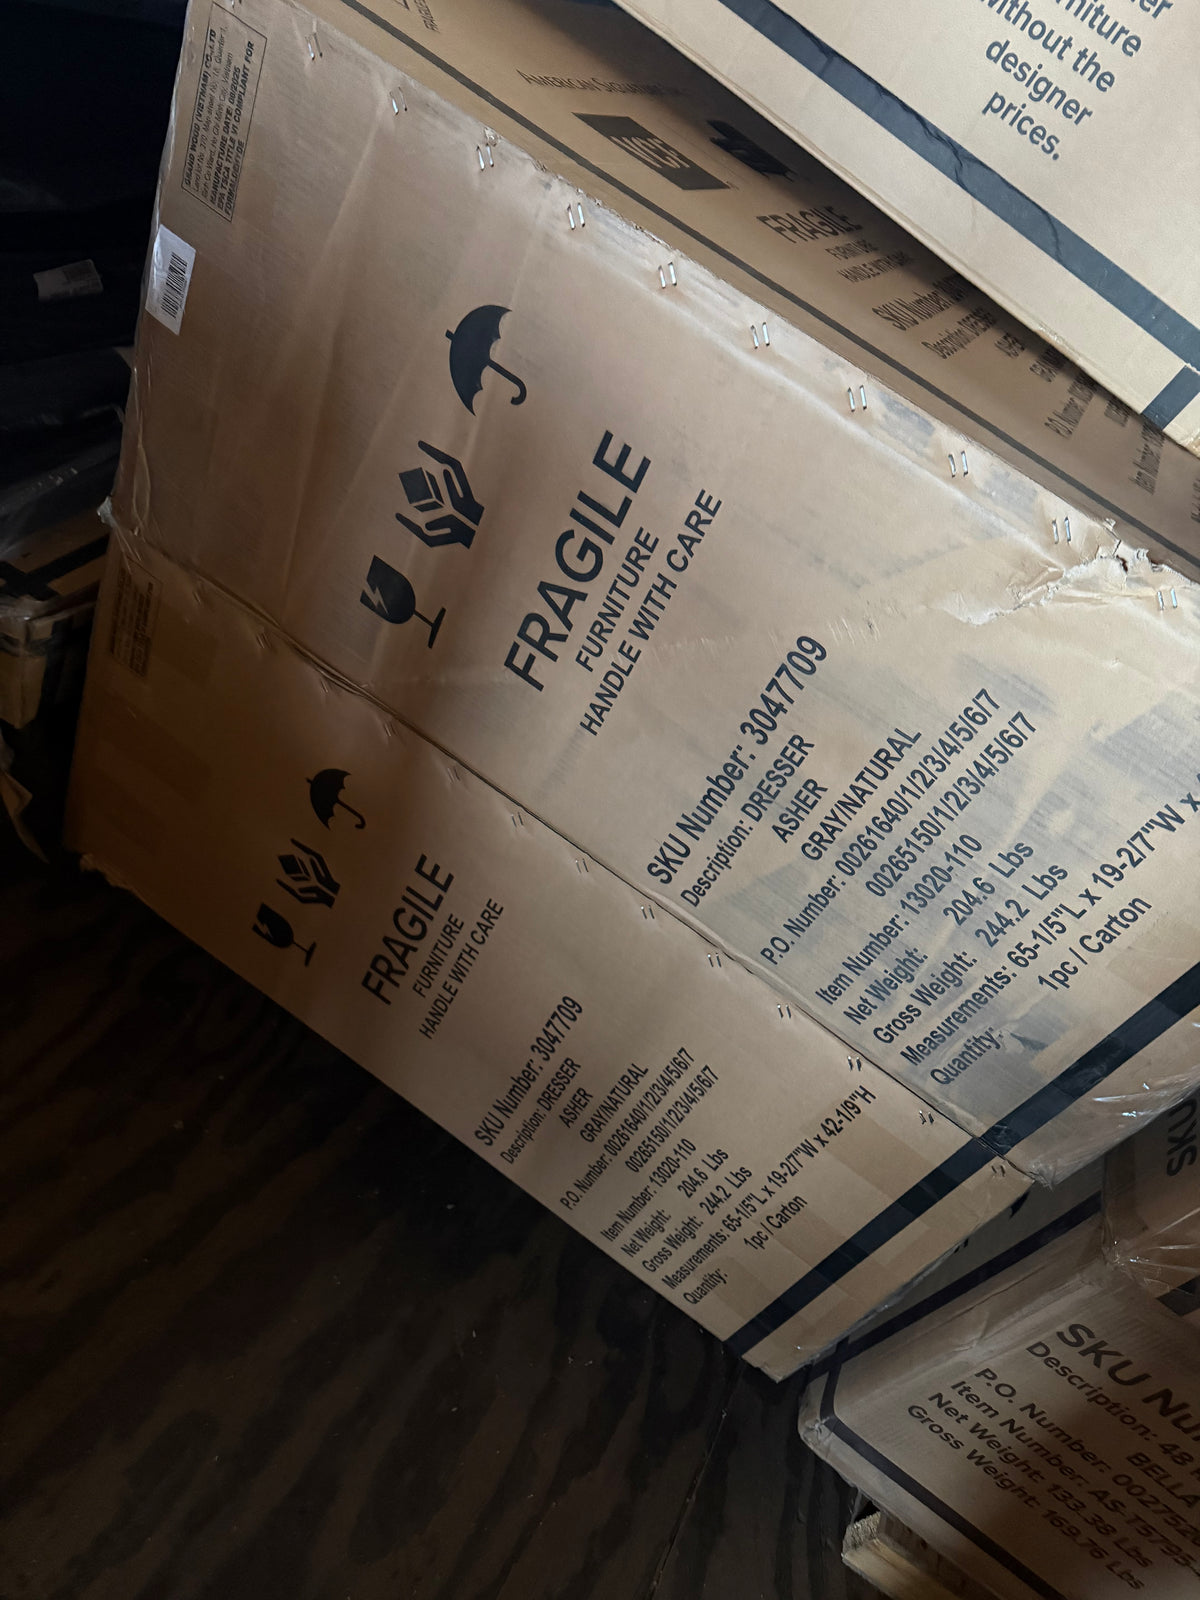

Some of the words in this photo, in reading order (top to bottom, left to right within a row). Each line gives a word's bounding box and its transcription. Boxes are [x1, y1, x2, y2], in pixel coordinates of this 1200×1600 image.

[220, 164, 230, 191] TSCA
[225, 135, 236, 164] TITLE
[233, 64, 249, 123] COMPLIANT
[244, 39, 254, 64] FOR
[985, 40, 1093, 125] designer
[1072, 48, 1115, 92] the
[190, 122, 200, 152] WOOD
[209, 134, 227, 205] MANUFACTURE
[222, 104, 233, 134] DATE:
[982, 92, 1060, 161] prices.
[756, 206, 863, 243] FRAGILE
[872, 297, 919, 331] SKU
[503, 430, 651, 692] FRAGILE
[575, 527, 660, 672] FURNITURE
[580, 640, 641, 736] HANDLE
[628, 573, 677, 640] WITH
[666, 489, 722, 573] CARE
[647, 833, 691, 885] SKU
[676, 745, 756, 841] Number:
[740, 635, 827, 745] 3047709
[772, 778, 829, 843] ASHER
[801, 728, 922, 861] GRAY/NATURAL
[865, 711, 1037, 897] 00265150/1/2/3/4/5/6/7
[681, 820, 753, 908] Description:
[741, 734, 815, 822] DRESSER
[760, 936, 795, 965] P.O.
[783, 875, 846, 937] Number:
[835, 688, 1000, 876] 00261640/1/2/3/4/5/6/7
[361, 854, 454, 1006] FRAGILE
[412, 913, 464, 998] FURNITURE
[419, 980, 458, 1039] HANDLE
[452, 943, 479, 985] WITH
[470, 899, 504, 945] CARE
[815, 973, 854, 1005] Item
[842, 914, 910, 977] Number:
[900, 834, 982, 914] 13020-110
[843, 995, 878, 1025] Net
[865, 948, 928, 1001] Weight:
[943, 877, 996, 926] 204.6
[988, 840, 1034, 878] Lbs
[873, 1004, 922, 1044] Gross
[910, 952, 977, 1006] Weight:
[975, 899, 1030, 948] 244.2
[1021, 863, 1068, 900] Lbs
[900, 965, 1017, 1066] Measurements:
[1007, 902, 1087, 968] 65-1/5"L
[1078, 888, 1102, 907] x
[1092, 803, 1185, 889] 19-2/7"W
[1073, 947, 1087, 965] /
[1079, 897, 1152, 955] Carton
[1038, 958, 1079, 991] 1pc
[474, 1116, 504, 1147] SKU
[492, 1058, 543, 1119] Number:
[530, 995, 583, 1062] 3047709
[558, 1087, 593, 1128] ASHER
[579, 1063, 649, 1143] GRAY/NATURAL
[930, 1026, 1004, 1085] Quantity:
[500, 1109, 546, 1165] Description:
[537, 1057, 581, 1111] DRESSER
[560, 1190, 583, 1211] P.O.
[574, 1157, 613, 1193] Number:
[603, 1047, 695, 1157] 00261640/1/2/3/4/5/6/7
[625, 1065, 719, 1173] 00265150/1/2/3/4/5/6/7
[767, 1139, 819, 1188] 19-2/7"W
[813, 1133, 829, 1148] x
[817, 1085, 877, 1137] 42-1/9"H
[1166, 1101, 1198, 1177] SKU
[600, 1220, 625, 1242] Item
[616, 1185, 657, 1224] Number:
[650, 1138, 697, 1188] 13020-110
[621, 1234, 643, 1258] Net
[635, 1209, 672, 1245] Weight:
[677, 1167, 709, 1198] 204.6
[702, 1148, 729, 1172] Lbs
[642, 1246, 673, 1273] Gross
[665, 1216, 703, 1252] Weight:
[699, 1184, 731, 1216] 244.2
[724, 1165, 752, 1189] Lbs
[721, 1193, 767, 1233] 65-1/5"L
[761, 1184, 776, 1198] x
[661, 1227, 730, 1290] Measurements:
[683, 1268, 728, 1305] Quantity:
[743, 1224, 769, 1251] 1pc
[765, 1195, 808, 1229] Carton
[1026, 1341, 1158, 1441] Description:
[1158, 1443, 1195, 1466] 48
[1056, 1323, 1152, 1386] SKU
[950, 1381, 999, 1418] Item
[999, 1418, 1091, 1487] Number:
[975, 1368, 1017, 1403] P.O.
[1020, 1403, 1112, 1472] Number:
[908, 1405, 964, 1450] Gross
[966, 1449, 1041, 1508] Weight:
[1105, 1560, 1145, 1590] Lbs
[928, 1392, 969, 1424] Net
[969, 1422, 1046, 1483] Weight:
[1114, 1537, 1153, 1567] Lbs
[1126, 1452, 1200, 1508] BELLA
